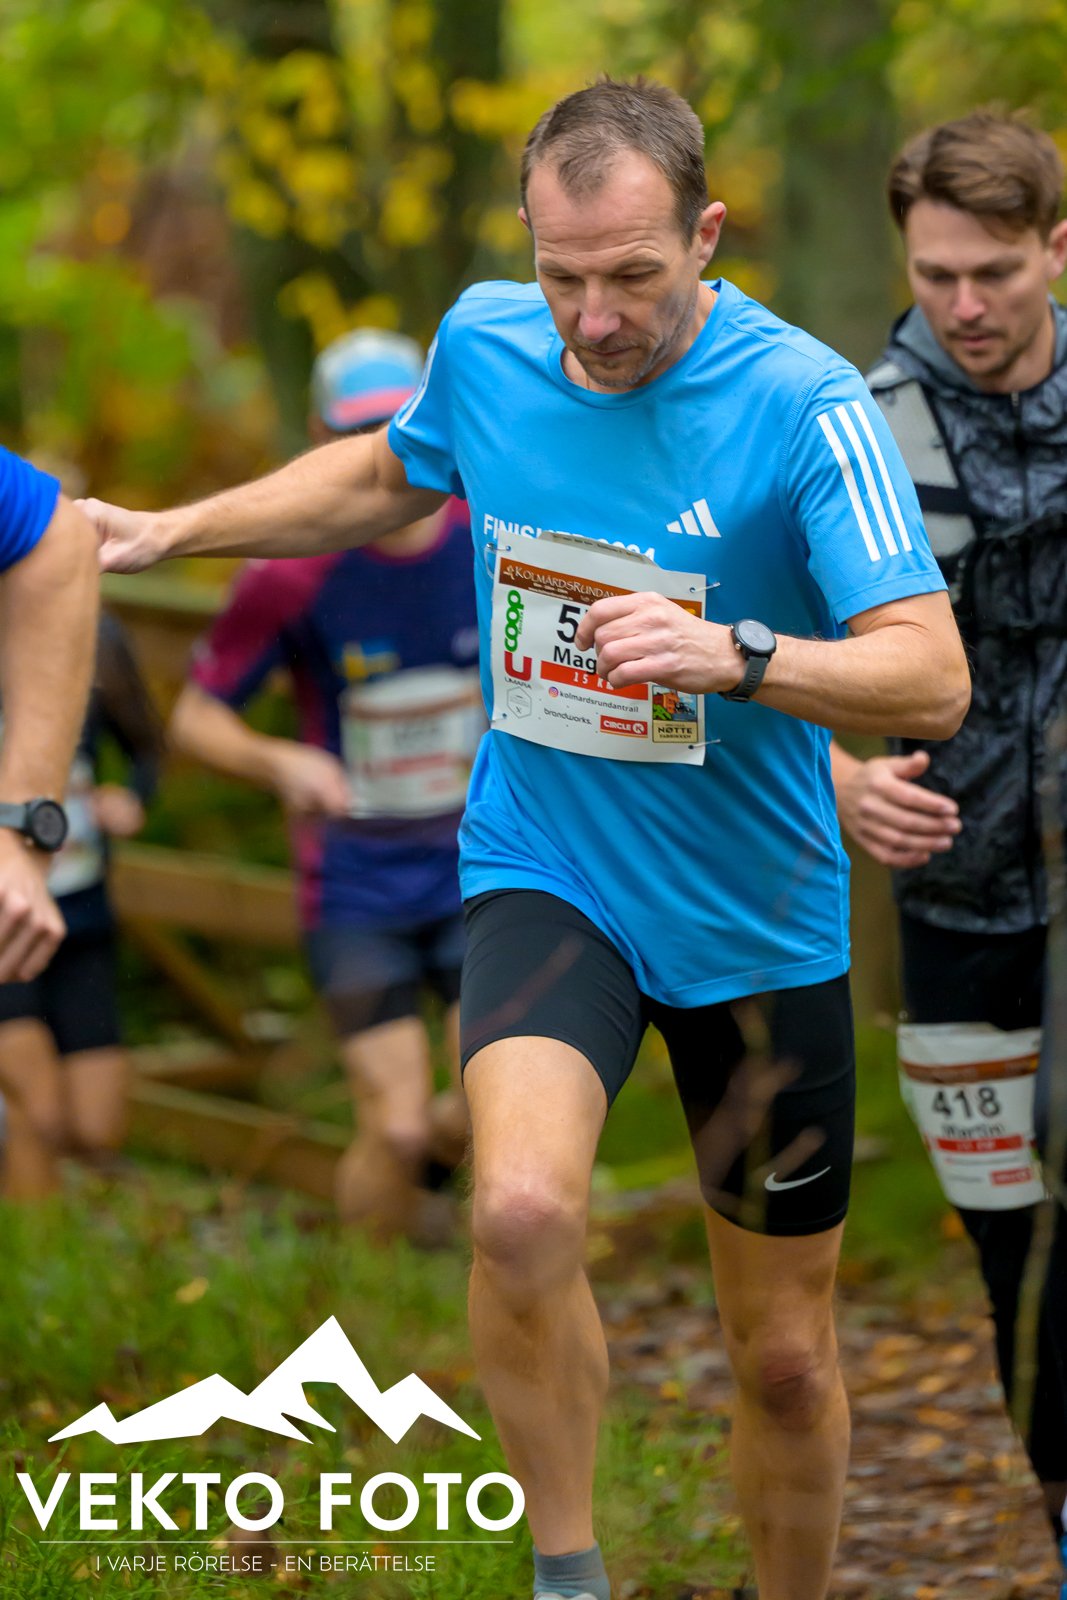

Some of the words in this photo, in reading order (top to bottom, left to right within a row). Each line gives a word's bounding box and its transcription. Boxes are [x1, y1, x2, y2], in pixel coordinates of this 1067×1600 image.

[504, 590, 524, 652] coop
[553, 645, 597, 675] Mag
[573, 671, 588, 685] 15
[560, 690, 638, 713] kolmardsrundantrail
[603, 720, 631, 732] CIRCLE
[633, 722, 645, 734] K
[658, 726, 693, 735] NØTTE
[932, 1086, 1001, 1119] 418
